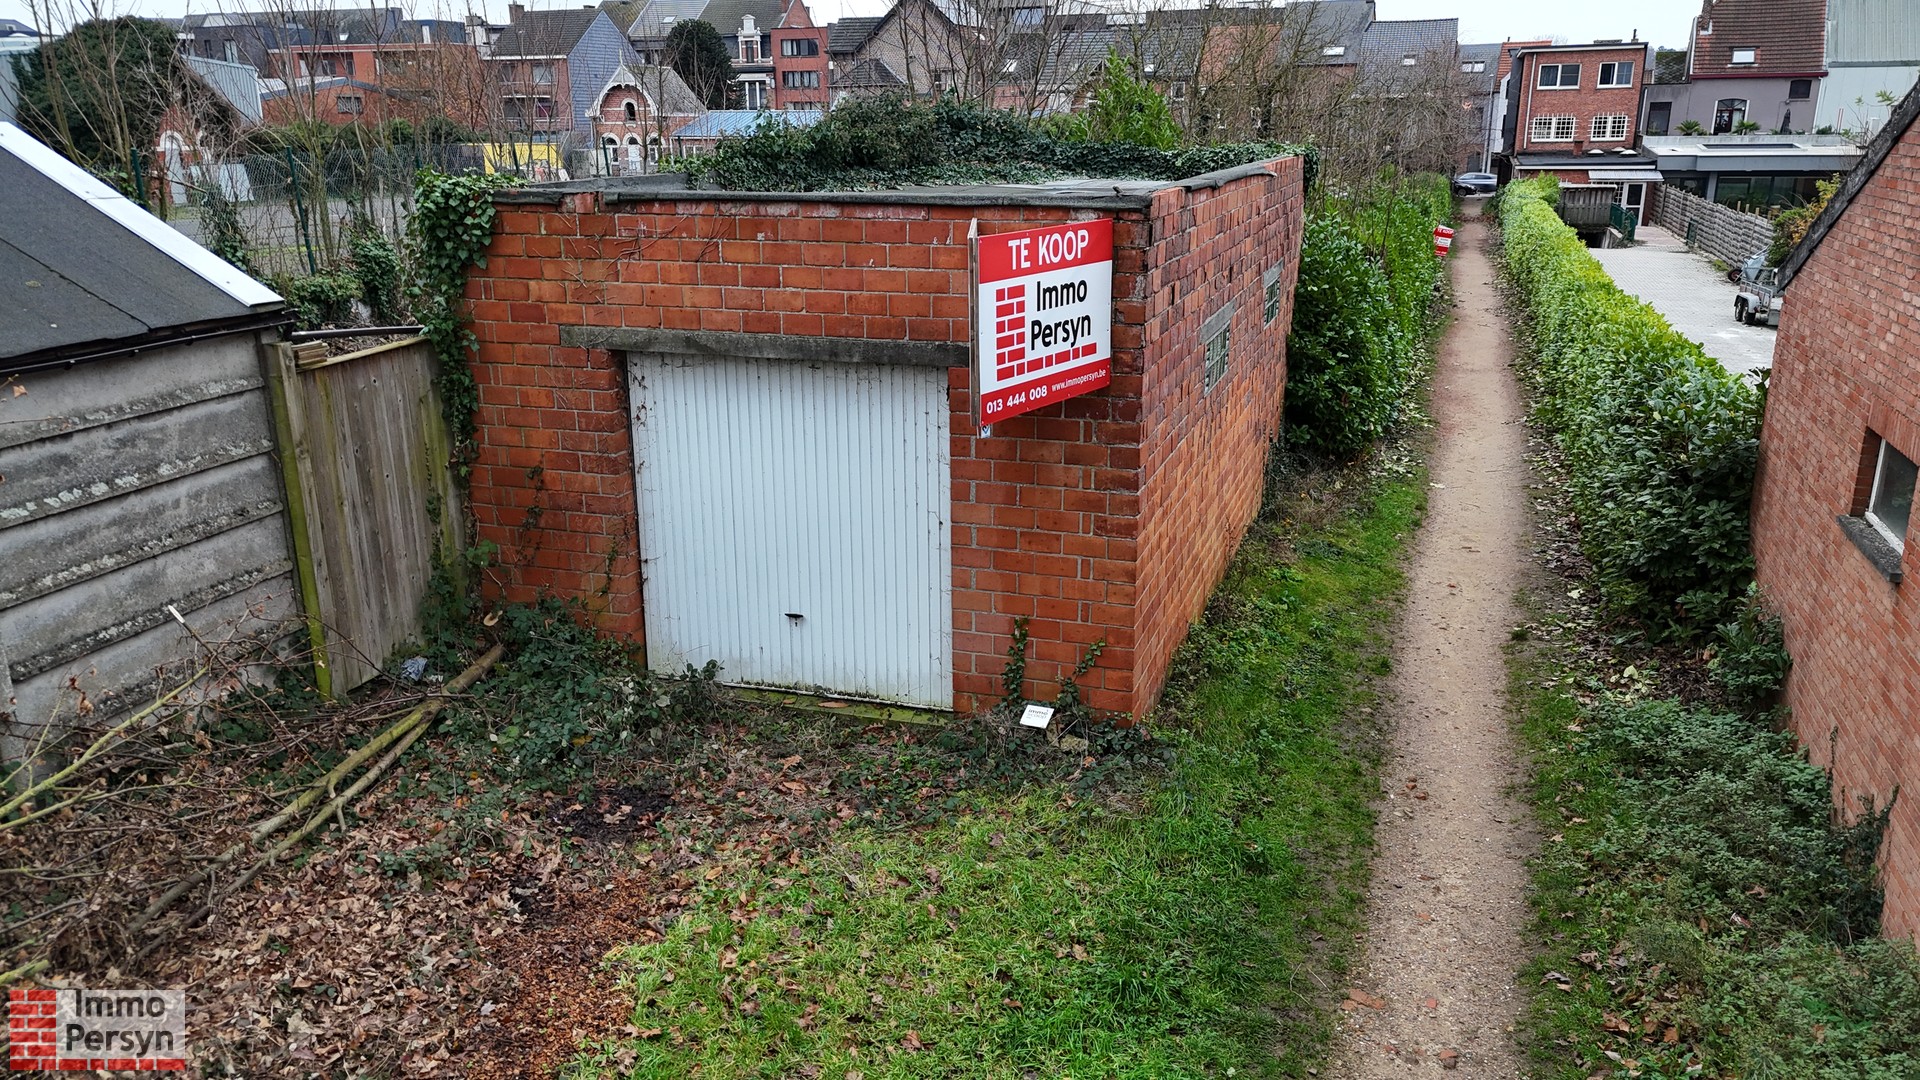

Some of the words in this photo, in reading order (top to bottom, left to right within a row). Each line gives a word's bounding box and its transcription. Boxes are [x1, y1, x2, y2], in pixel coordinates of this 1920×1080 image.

[1008, 237, 1031, 270] TE
[1038, 229, 1089, 266] KOOP
[1036, 279, 1088, 312] Immo
[1030, 314, 1091, 351] Persyn
[986, 398, 1003, 414] 013
[1006, 391, 1026, 407] 444
[1029, 385, 1048, 401] 008
[1051, 368, 1106, 392] www.immopersyn.be
